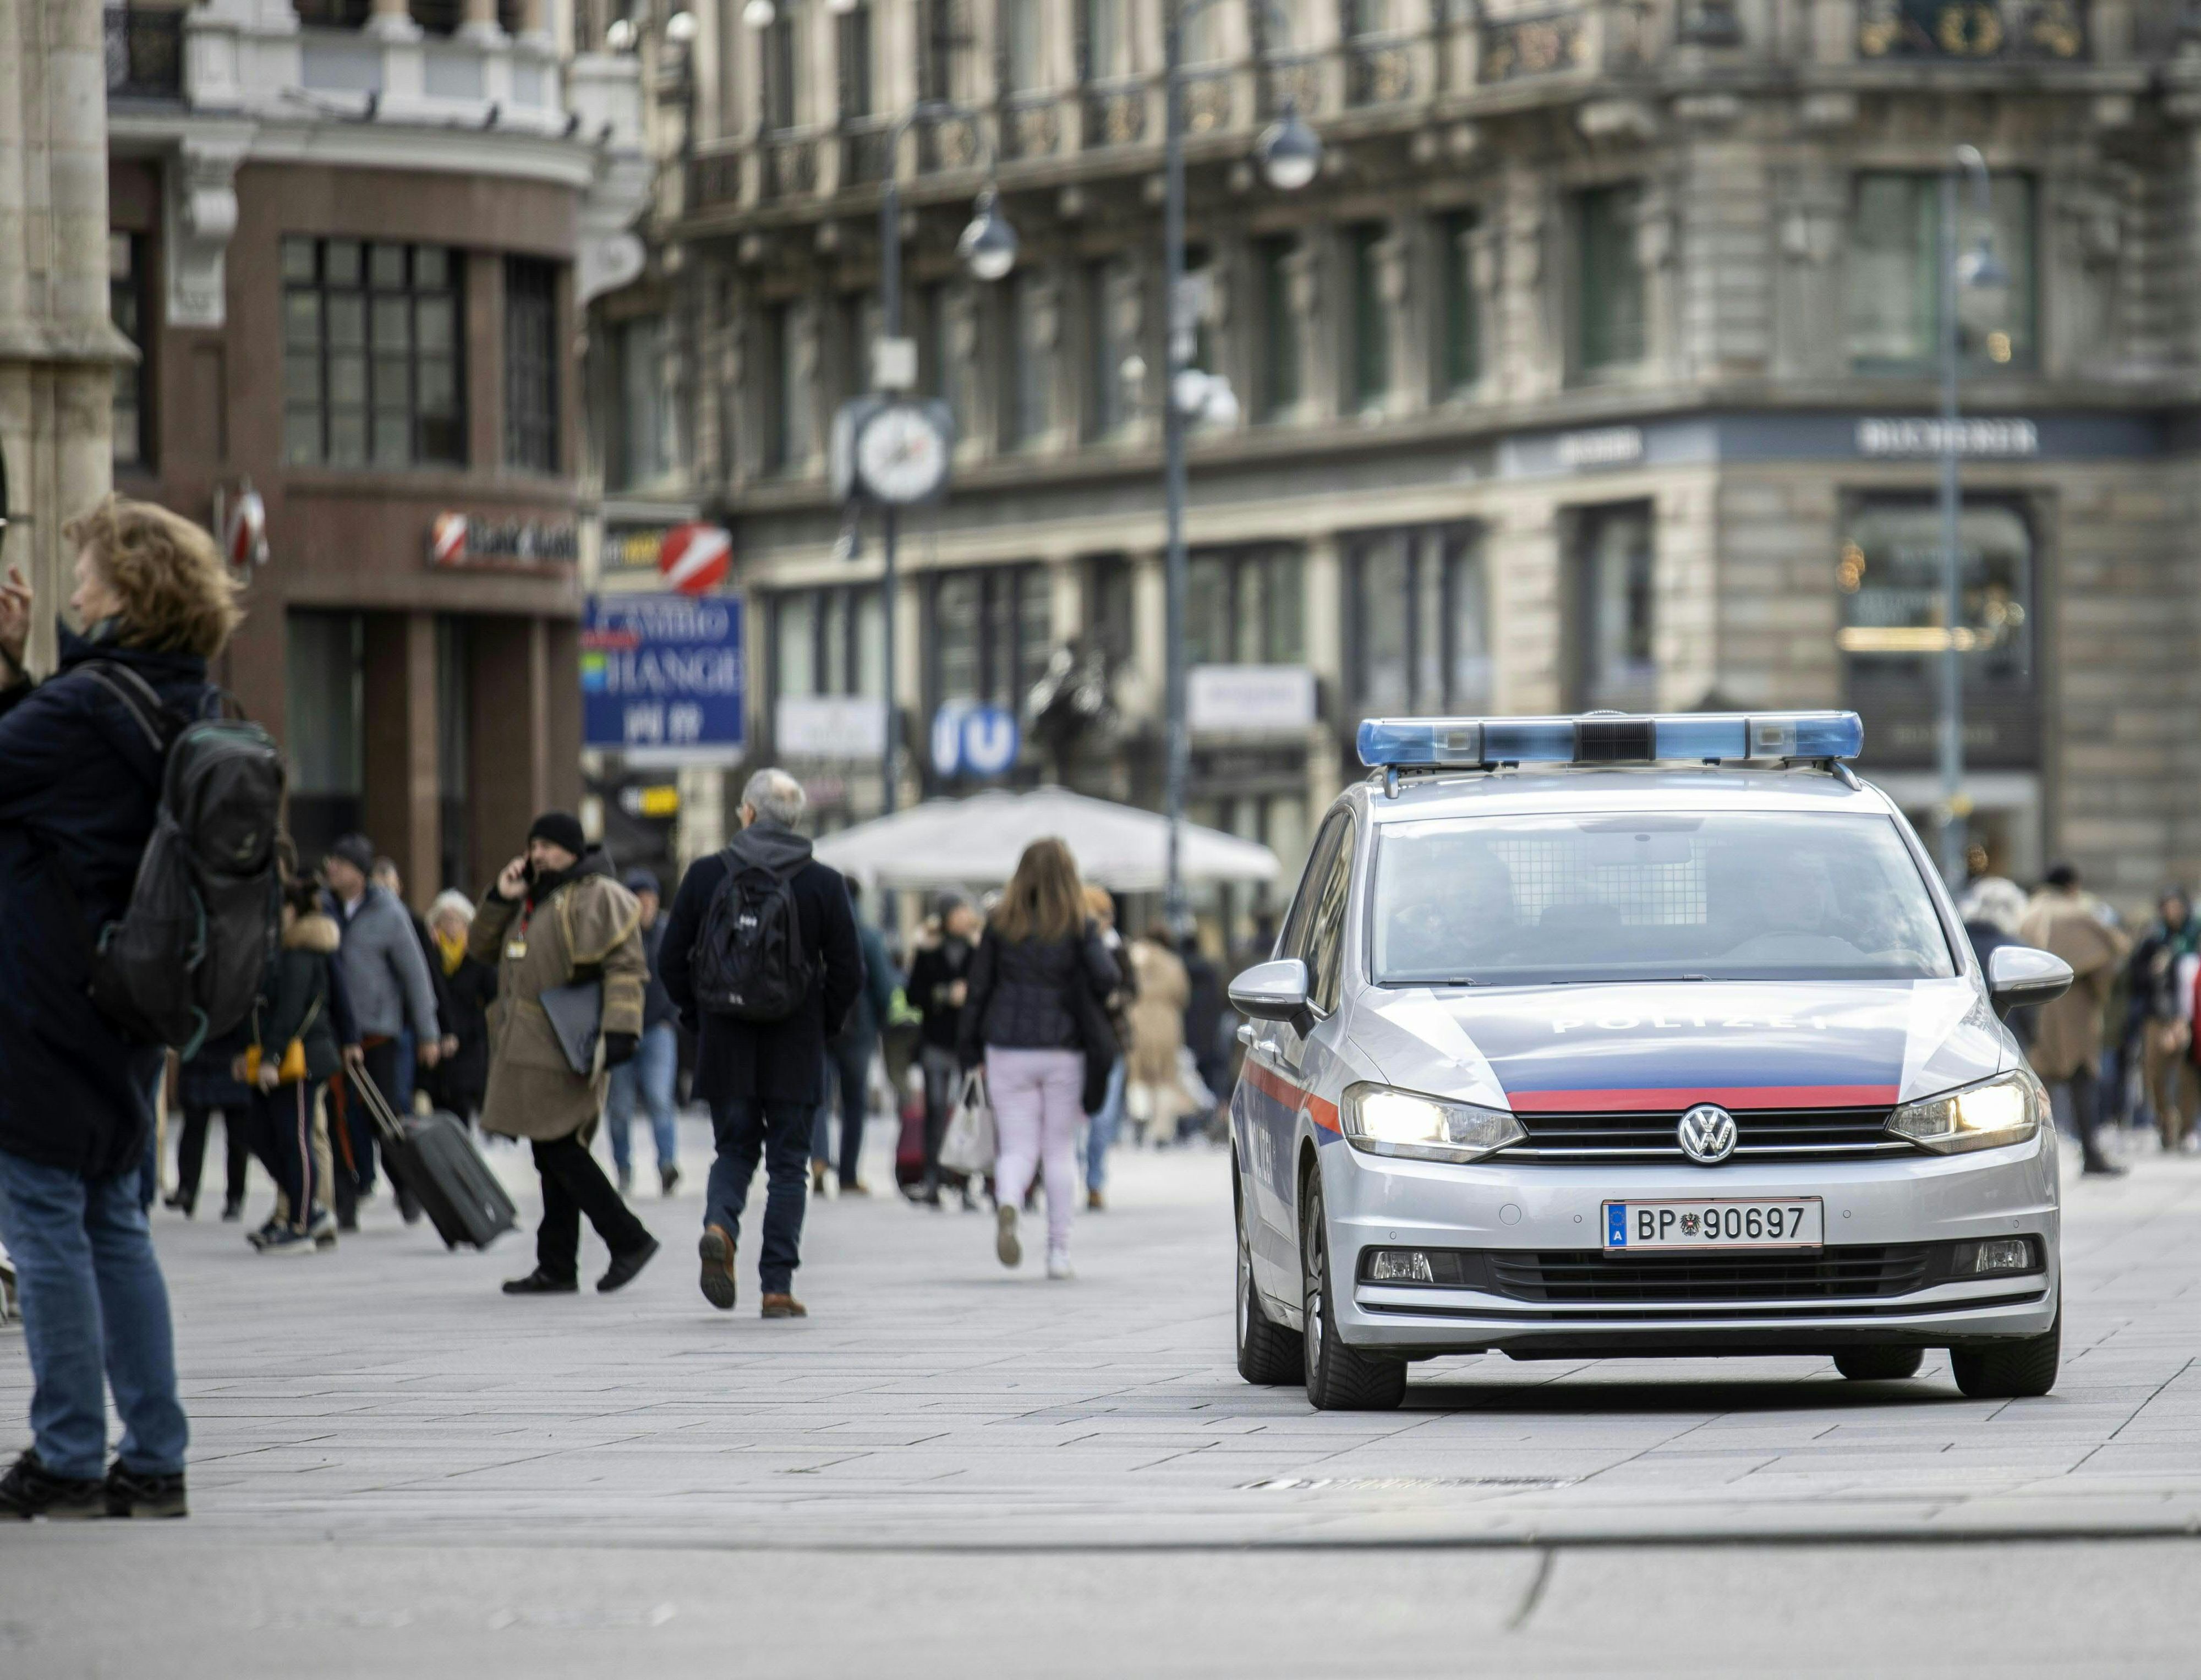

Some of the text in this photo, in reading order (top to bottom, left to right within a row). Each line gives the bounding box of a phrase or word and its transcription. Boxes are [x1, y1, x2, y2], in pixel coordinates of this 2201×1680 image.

[606, 648, 741, 695] HANGE
[1553, 1014, 1826, 1033] POLIZEI
[1613, 1230, 1623, 1240] A
[1638, 1207, 1805, 1240] BP 90697
